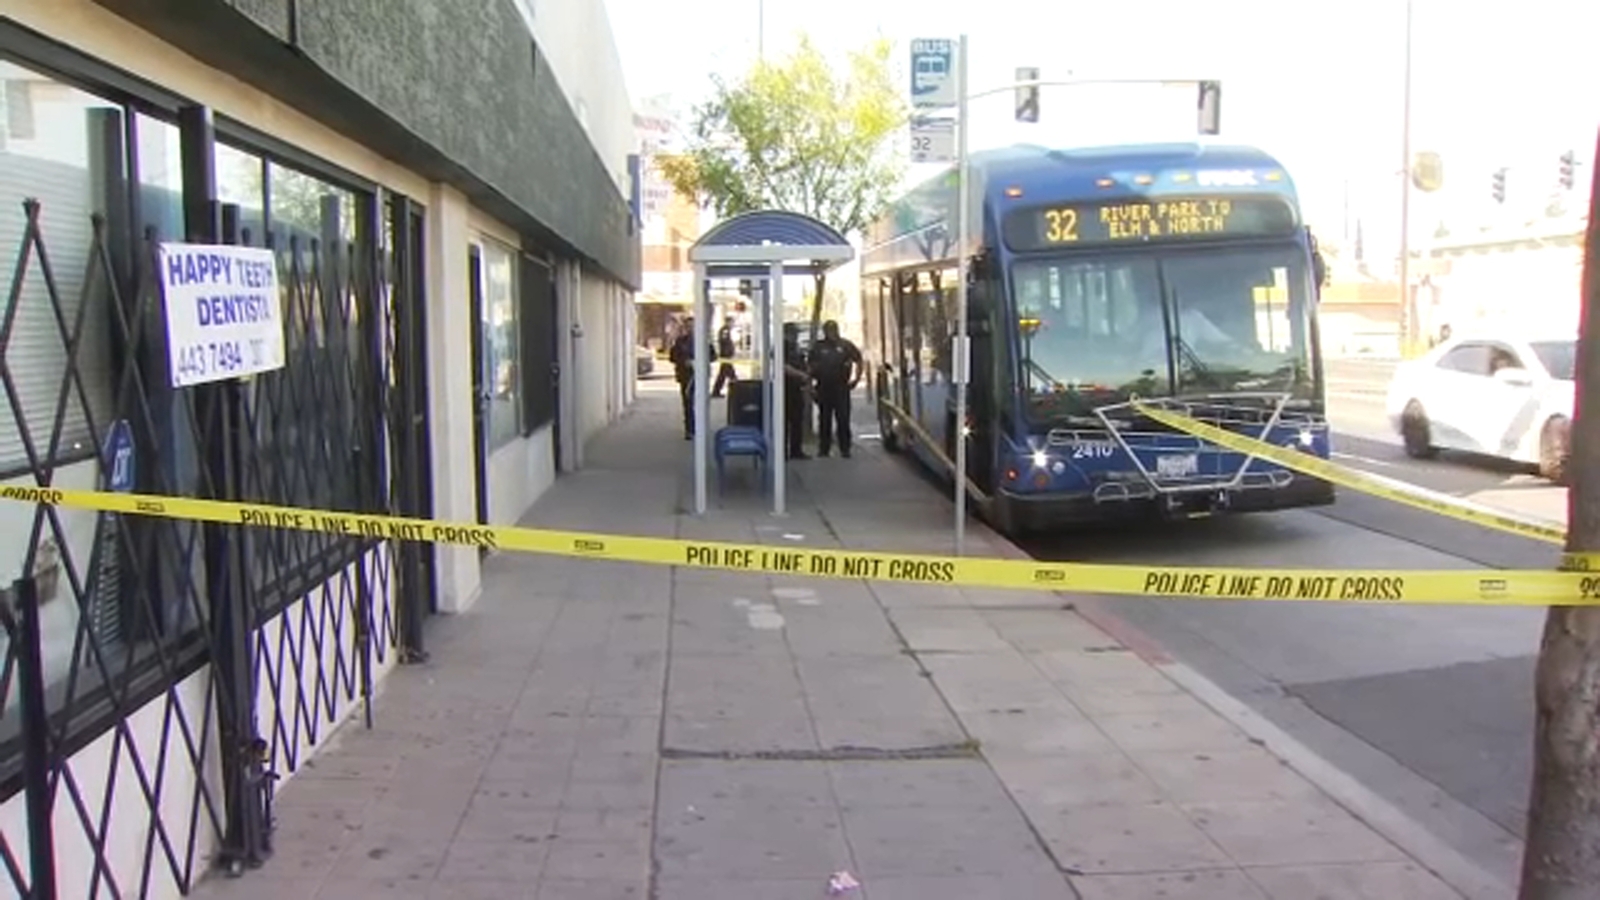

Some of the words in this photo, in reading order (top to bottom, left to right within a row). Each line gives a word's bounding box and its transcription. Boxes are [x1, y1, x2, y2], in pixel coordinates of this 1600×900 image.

[912, 136, 931, 151] 32
[1045, 208, 1078, 241] 32
[1100, 203, 1151, 222] RIVER
[1157, 202, 1201, 216] PARK
[1208, 200, 1231, 215] TO
[1109, 219, 1142, 239] ELM
[1149, 218, 1161, 236] &
[1168, 215, 1225, 233] NORTH
[168, 253, 232, 286] HAPPY
[235, 257, 274, 289] TEETH
[208, 340, 243, 372] 7494
[1072, 443, 1114, 460] 2410
[238, 508, 303, 530] POLICE
[311, 516, 350, 535] LINE
[357, 519, 382, 540] DO
[388, 523, 425, 543] NOT
[432, 526, 497, 548] CROSS
[686, 546, 754, 569] POLICE
[760, 552, 804, 572] LINE
[810, 555, 836, 575] DO
[842, 557, 883, 578] NOT
[888, 559, 955, 582] CROSS
[1143, 571, 1214, 596] POLICE
[1216, 575, 1261, 598] LINE
[1264, 576, 1293, 598] DO
[1298, 576, 1338, 600] NOT
[1339, 577, 1404, 601] CROSS
